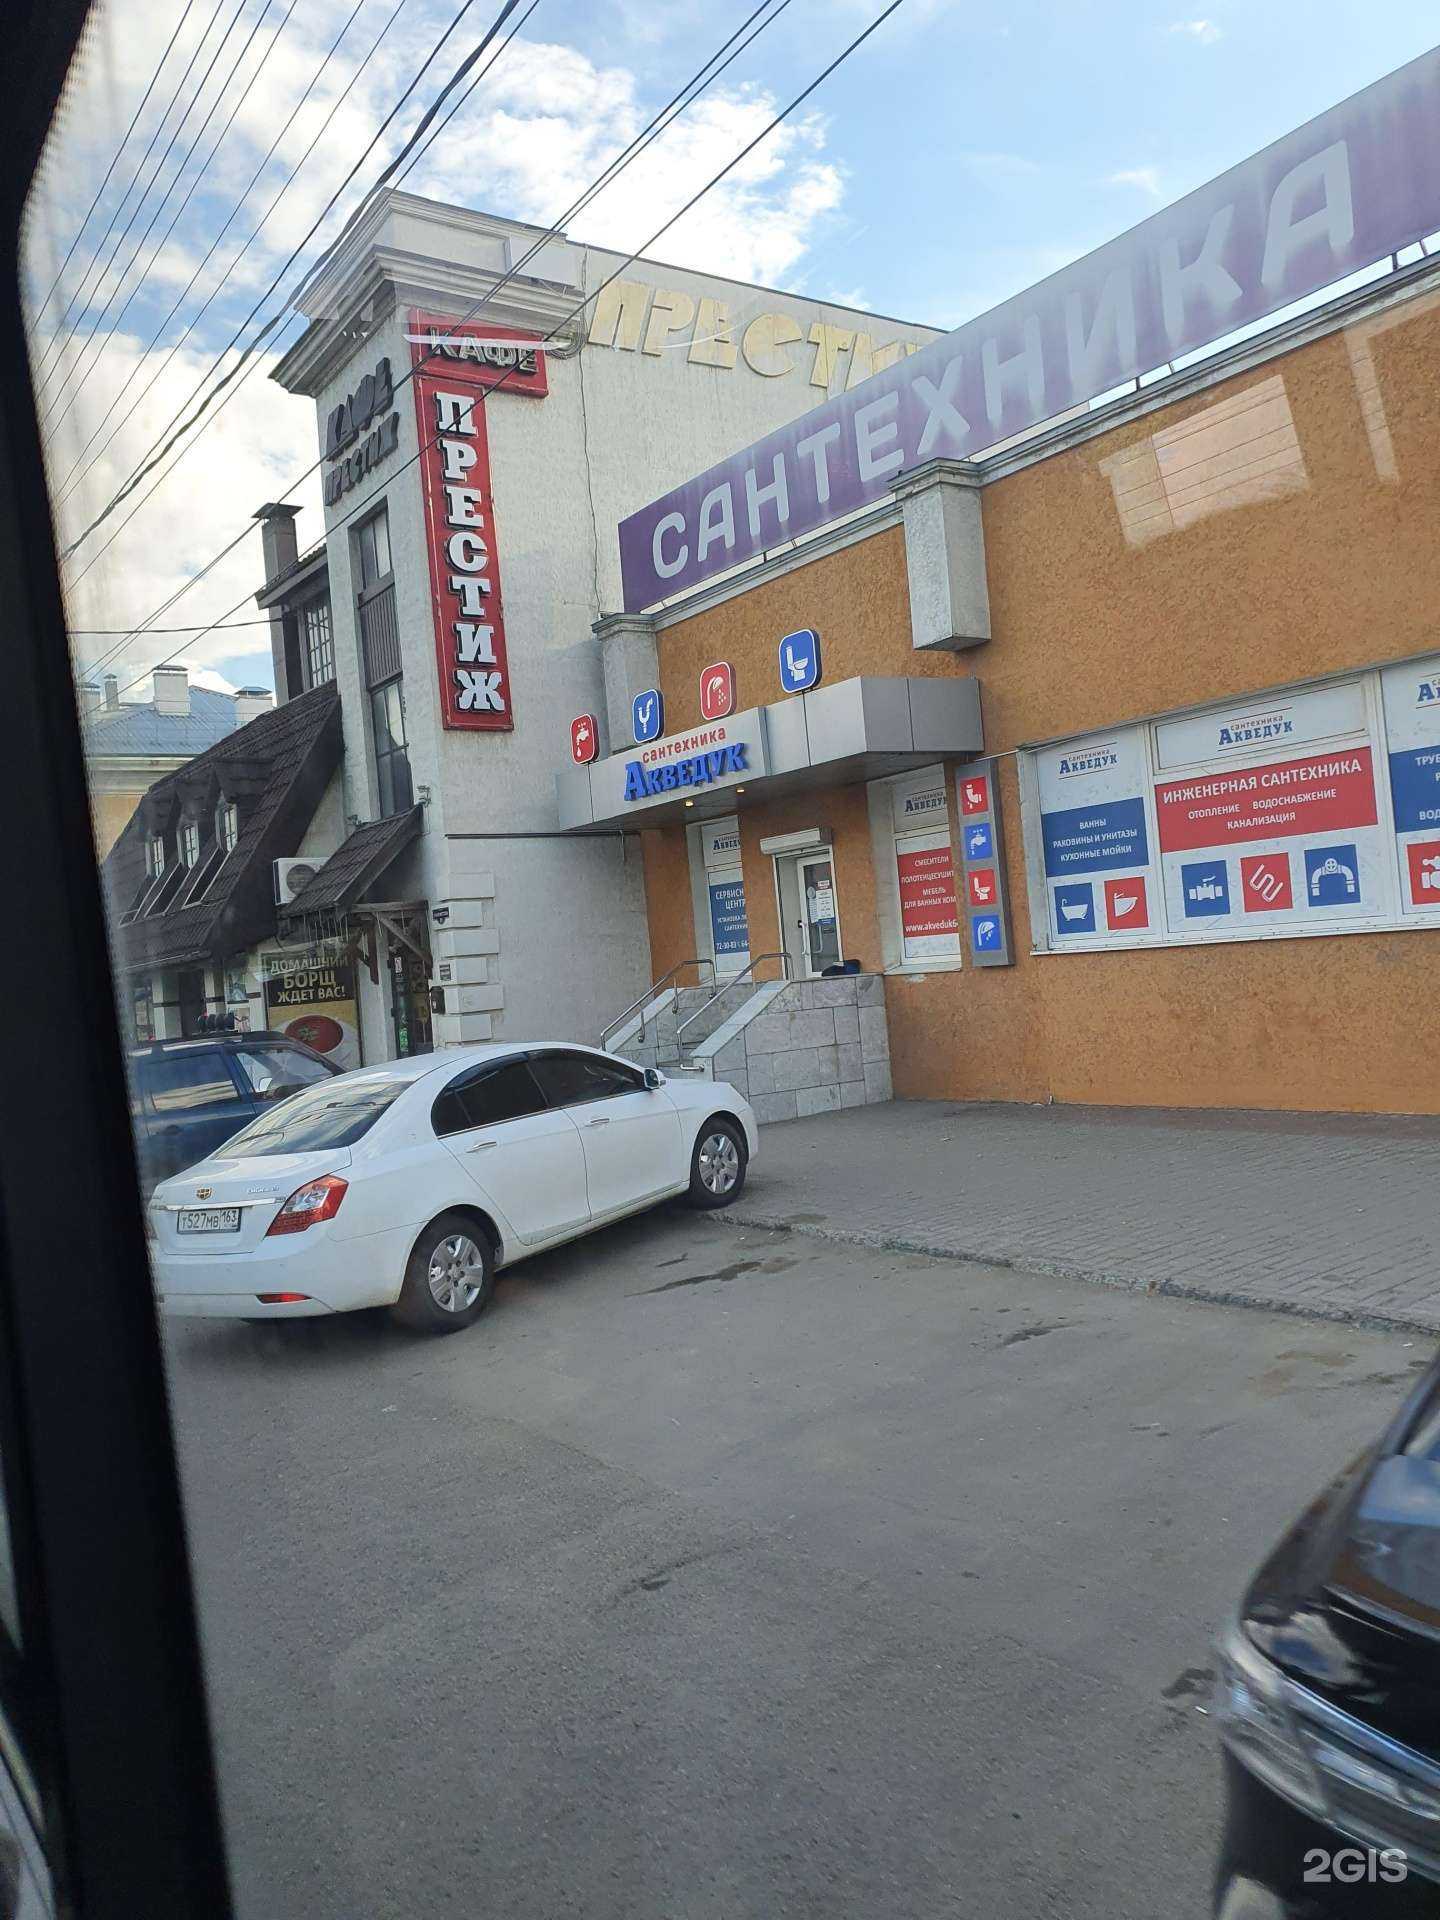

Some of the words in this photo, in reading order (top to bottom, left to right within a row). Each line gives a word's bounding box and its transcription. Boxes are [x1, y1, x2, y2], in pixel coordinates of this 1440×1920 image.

[588, 279, 924, 391] ПРЕСТИ
[426, 326, 539, 376] КАФЕ
[651, 138, 1358, 580] САНТЕХНИКА
[434, 391, 505, 712] ПРЕСТИЖ
[1230, 714, 1284, 731] сантехника
[642, 727, 727, 764] сантехника
[1163, 776, 1257, 804] ИНЖЕНЕРНАЯ
[1261, 758, 1362, 788] САНТЕХНИКА
[1188, 803, 1241, 820] ОТОПЛЕНИЕ
[1252, 788, 1337, 810] ВОДОСНАБЖЕНИЕ
[1079, 818, 1107, 830] ВАННЫ
[1227, 811, 1296, 830] КАНАЛИЗАЦИЯ
[1053, 837, 1094, 849] РАКОВИНЫ
[1095, 834, 1100, 842] И
[1102, 829, 1138, 842] УНИТАЗЫ
[1060, 848, 1101, 862] КУХОННЫЕ
[1103, 844, 1132, 856] МОЙКИ
[923, 886, 946, 896] МЕБЕЛЬ
[283, 970, 336, 989] БОРЩ
[278, 988, 315, 1004] ЖДЕТ
[318, 985, 346, 1000] ВАС!
[221, 1210, 237, 1223] 163
